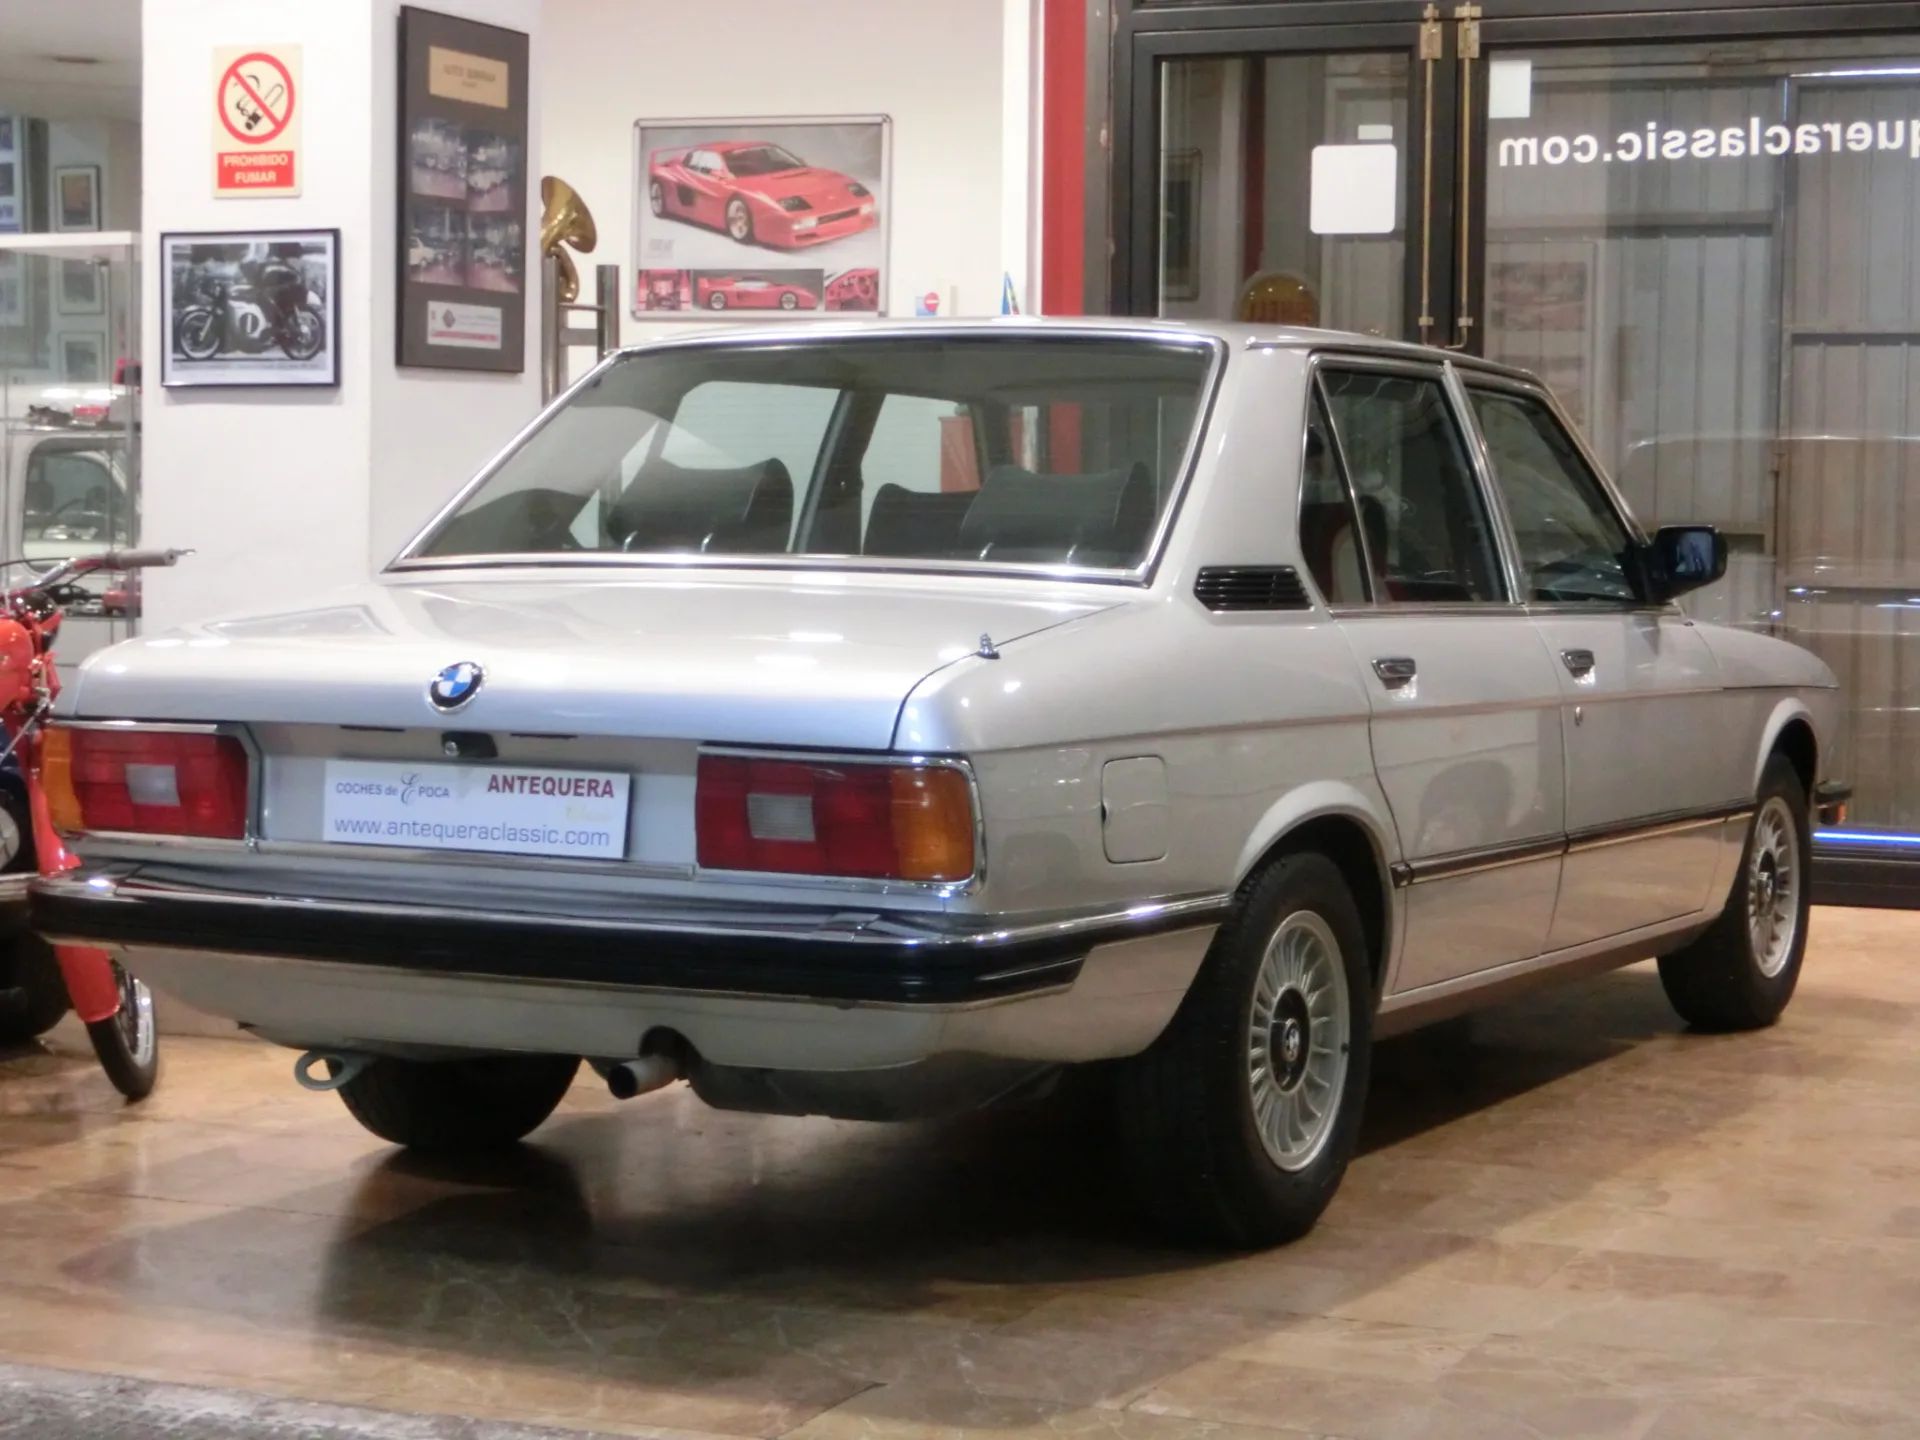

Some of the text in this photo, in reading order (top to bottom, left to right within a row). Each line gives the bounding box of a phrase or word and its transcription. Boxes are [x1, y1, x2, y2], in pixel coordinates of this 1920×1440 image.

[224, 153, 289, 168] PROHIBIDO
[235, 170, 277, 184] FUMAR
[336, 782, 382, 795] COCHES
[384, 786, 398, 796] de
[487, 774, 614, 798] ANTEQUERA
[334, 818, 610, 846] www.antequeraclassic.com
